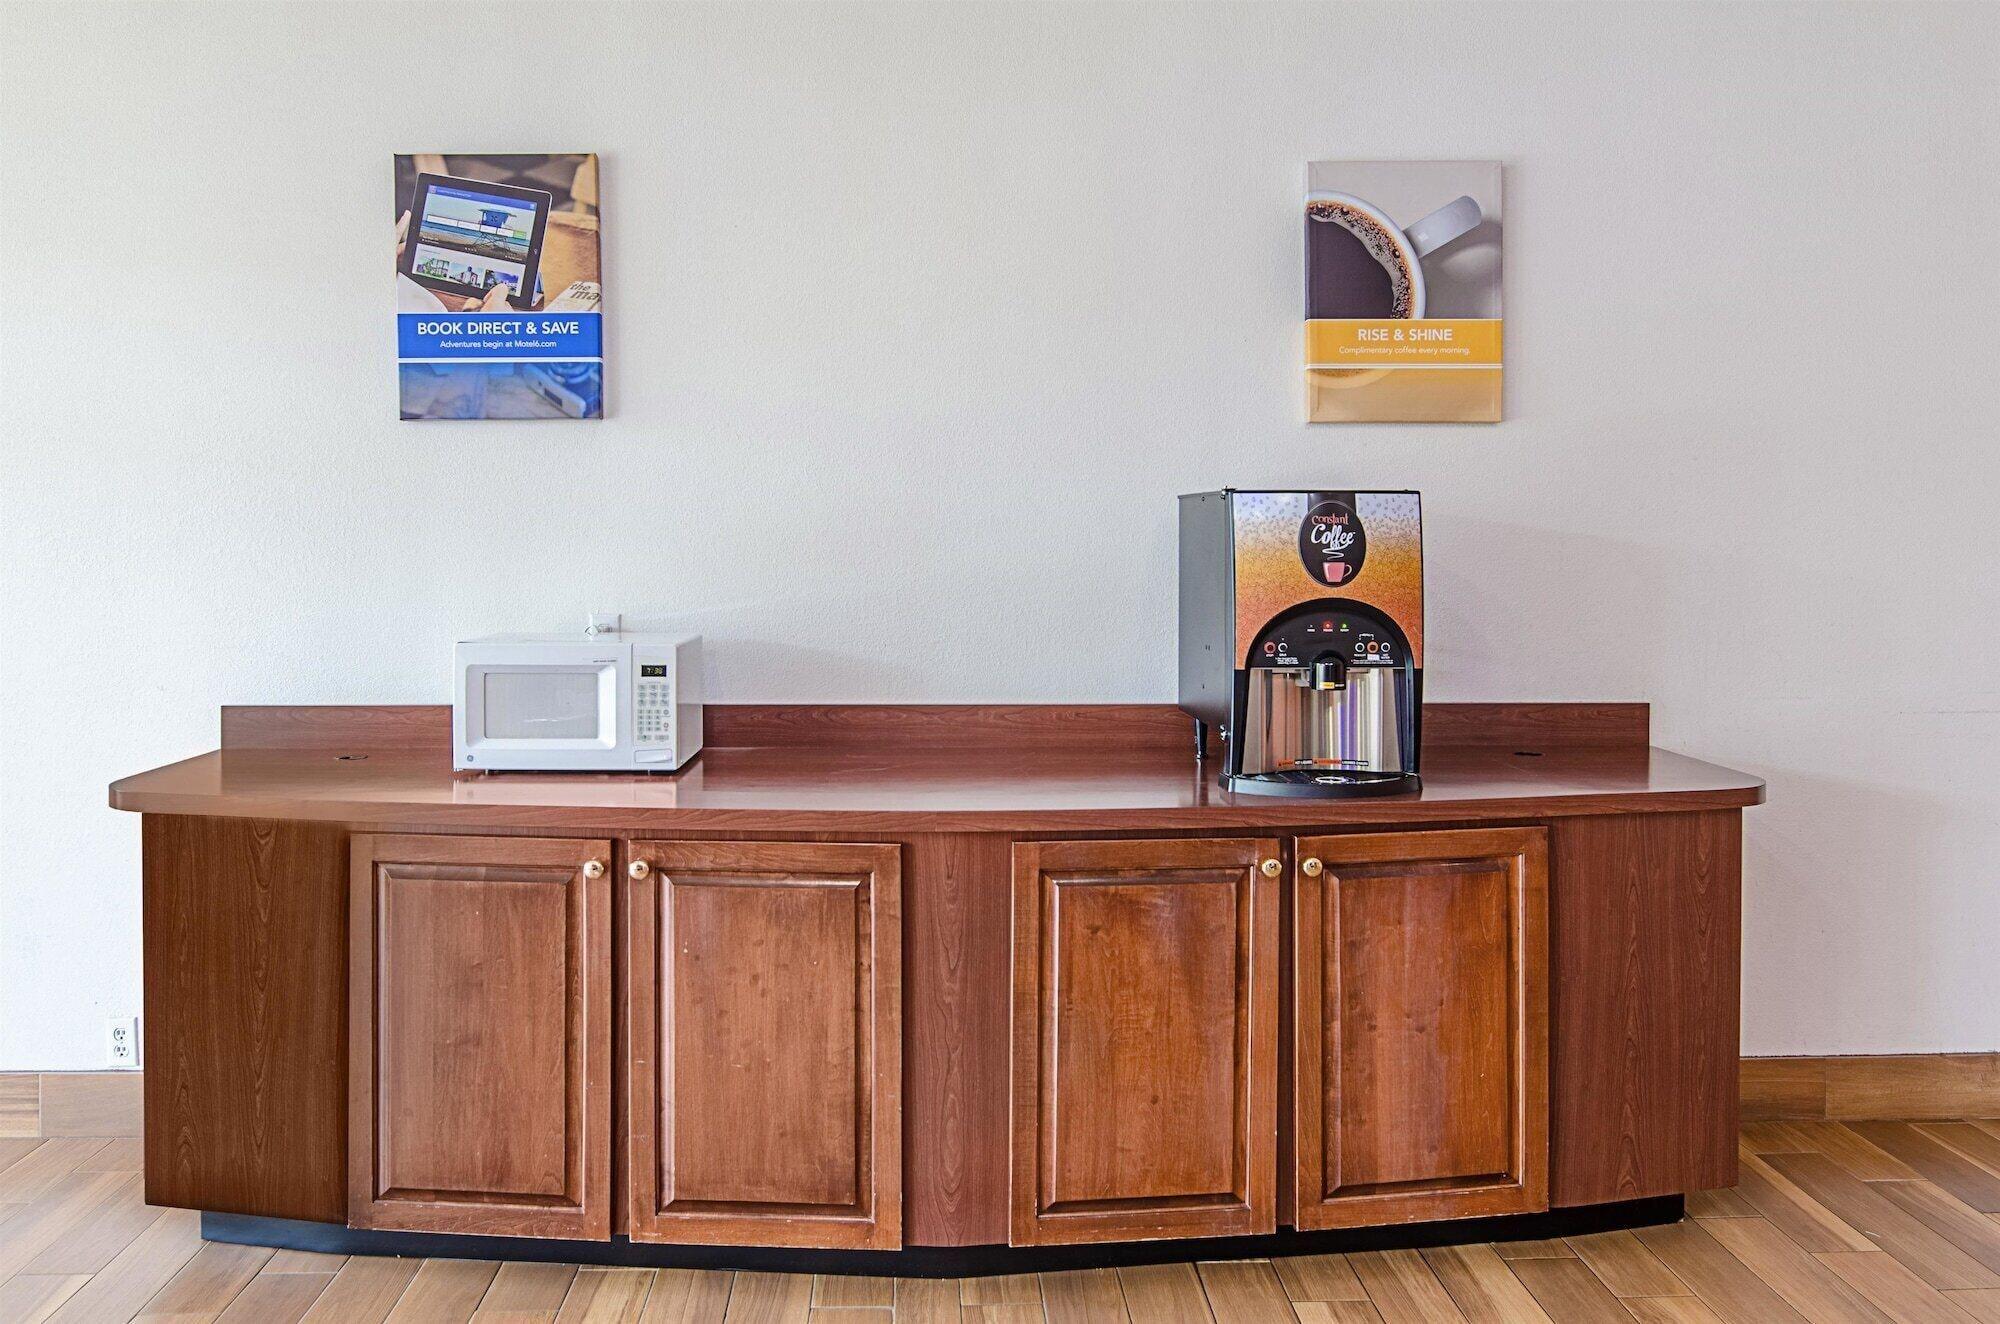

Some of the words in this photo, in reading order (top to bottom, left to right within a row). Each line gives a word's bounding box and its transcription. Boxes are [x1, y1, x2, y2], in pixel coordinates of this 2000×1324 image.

[417, 322, 463, 335] BOOK
[467, 321, 521, 335] DIRECT
[526, 321, 537, 335] &
[542, 321, 579, 335] SAVE
[1358, 329, 1389, 341] RISE
[1393, 329, 1404, 341] &
[1409, 329, 1453, 341] SHINE
[440, 340, 481, 348] Adventures
[483, 340, 503, 349] begin
[514, 340, 557, 348] Motel6.com
[1339, 345, 1393, 355] Complimentary
[1394, 345, 1417, 353] coffee
[1418, 347, 1438, 355] every
[1311, 523, 1355, 549] Coffee
